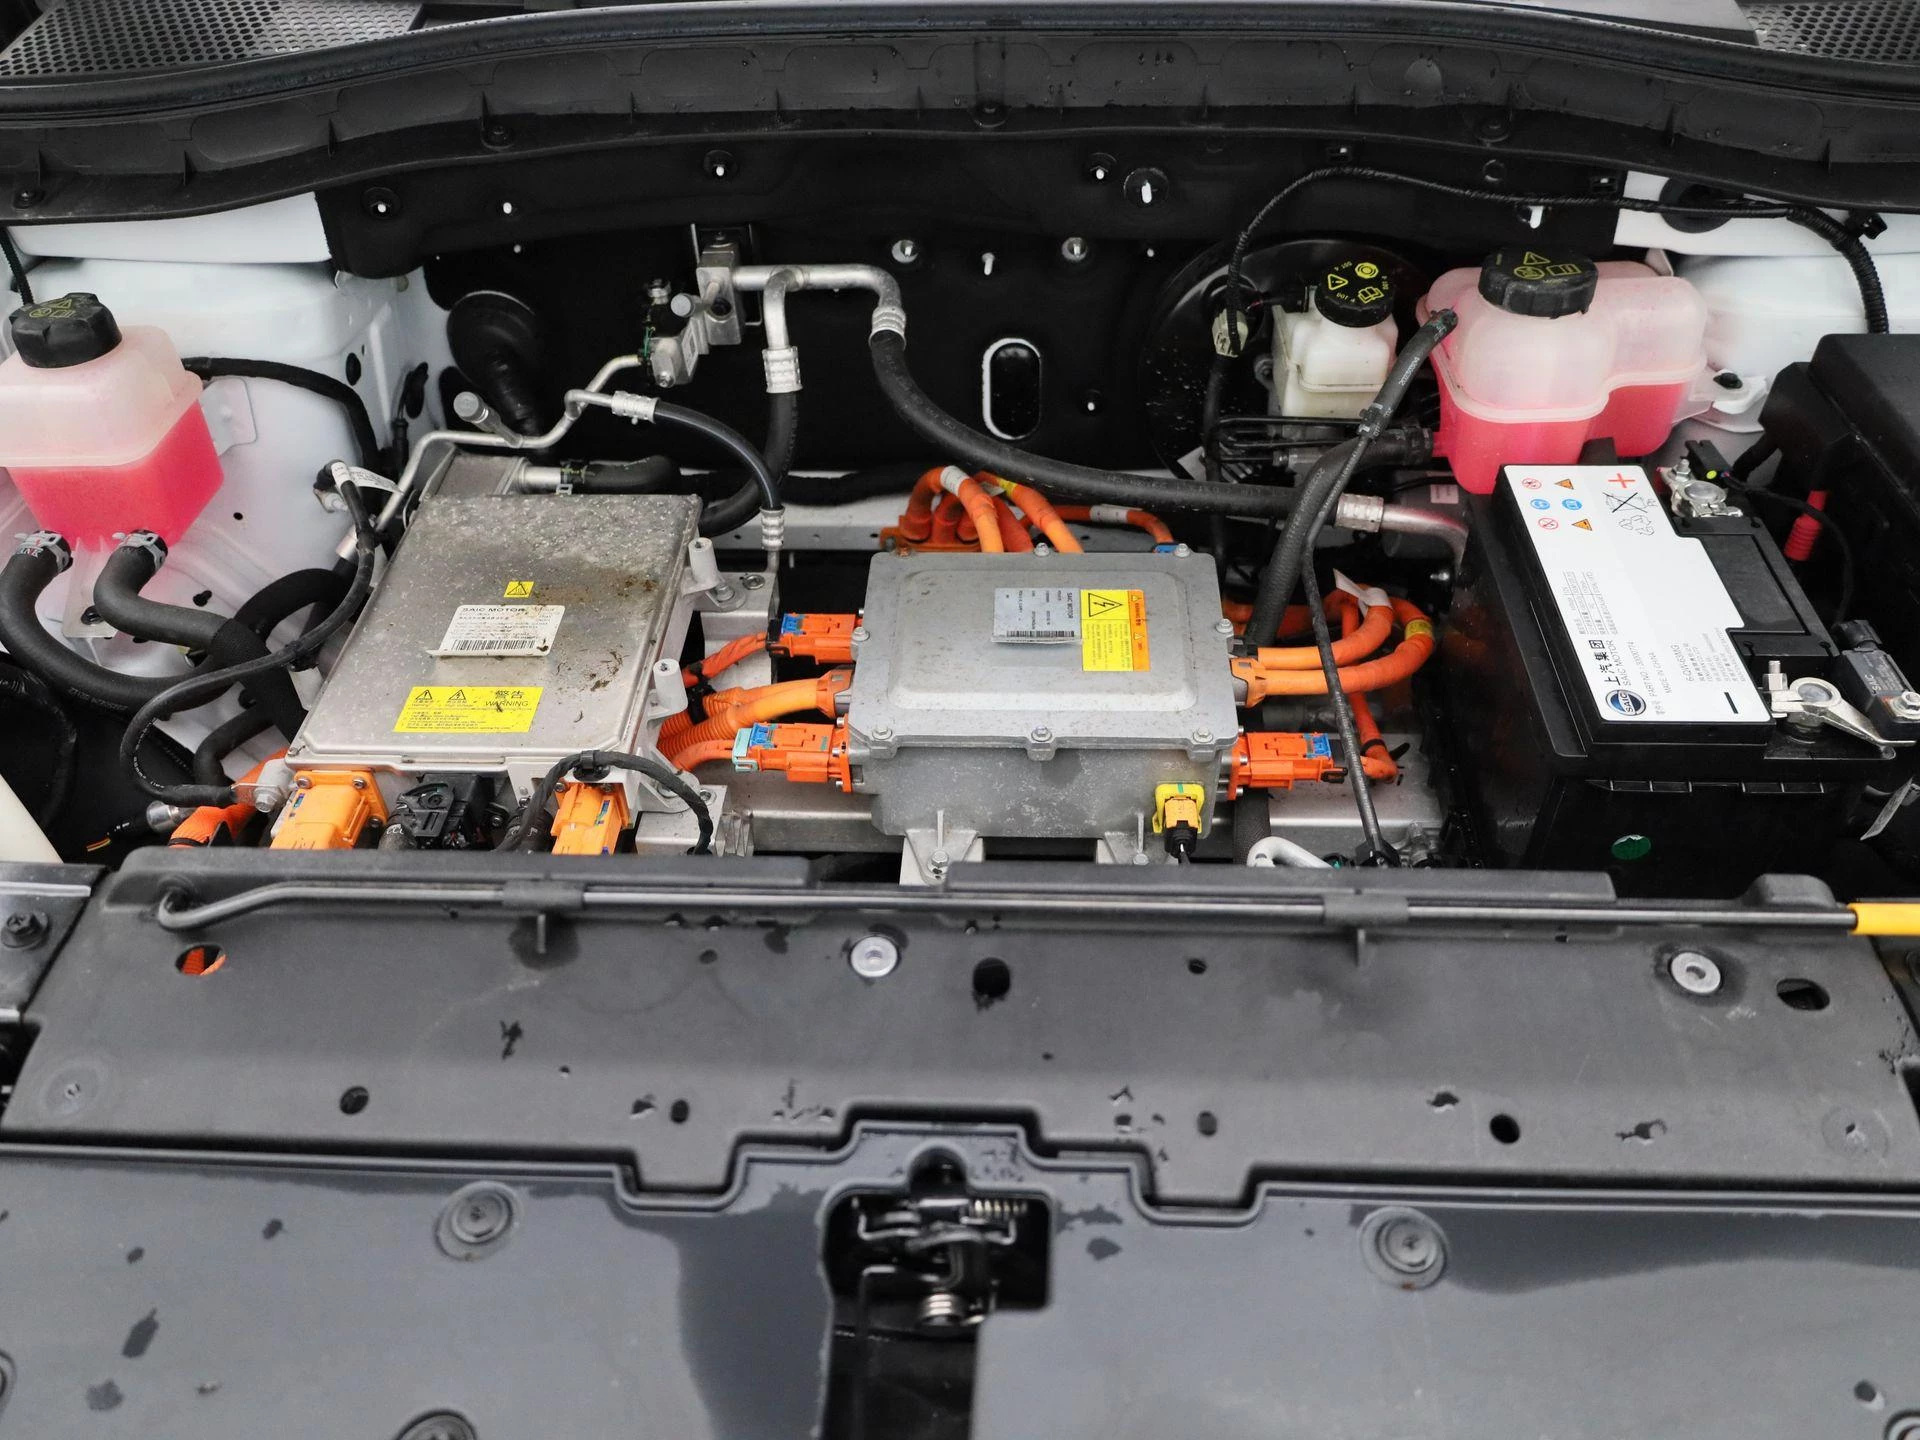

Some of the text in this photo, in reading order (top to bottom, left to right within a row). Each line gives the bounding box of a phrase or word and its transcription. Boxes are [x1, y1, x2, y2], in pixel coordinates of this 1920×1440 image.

[1589, 640, 1621, 686] 上汽集团
[1606, 640, 1632, 686] SAIC MOTOR
[1619, 692, 1634, 713] SAIC
